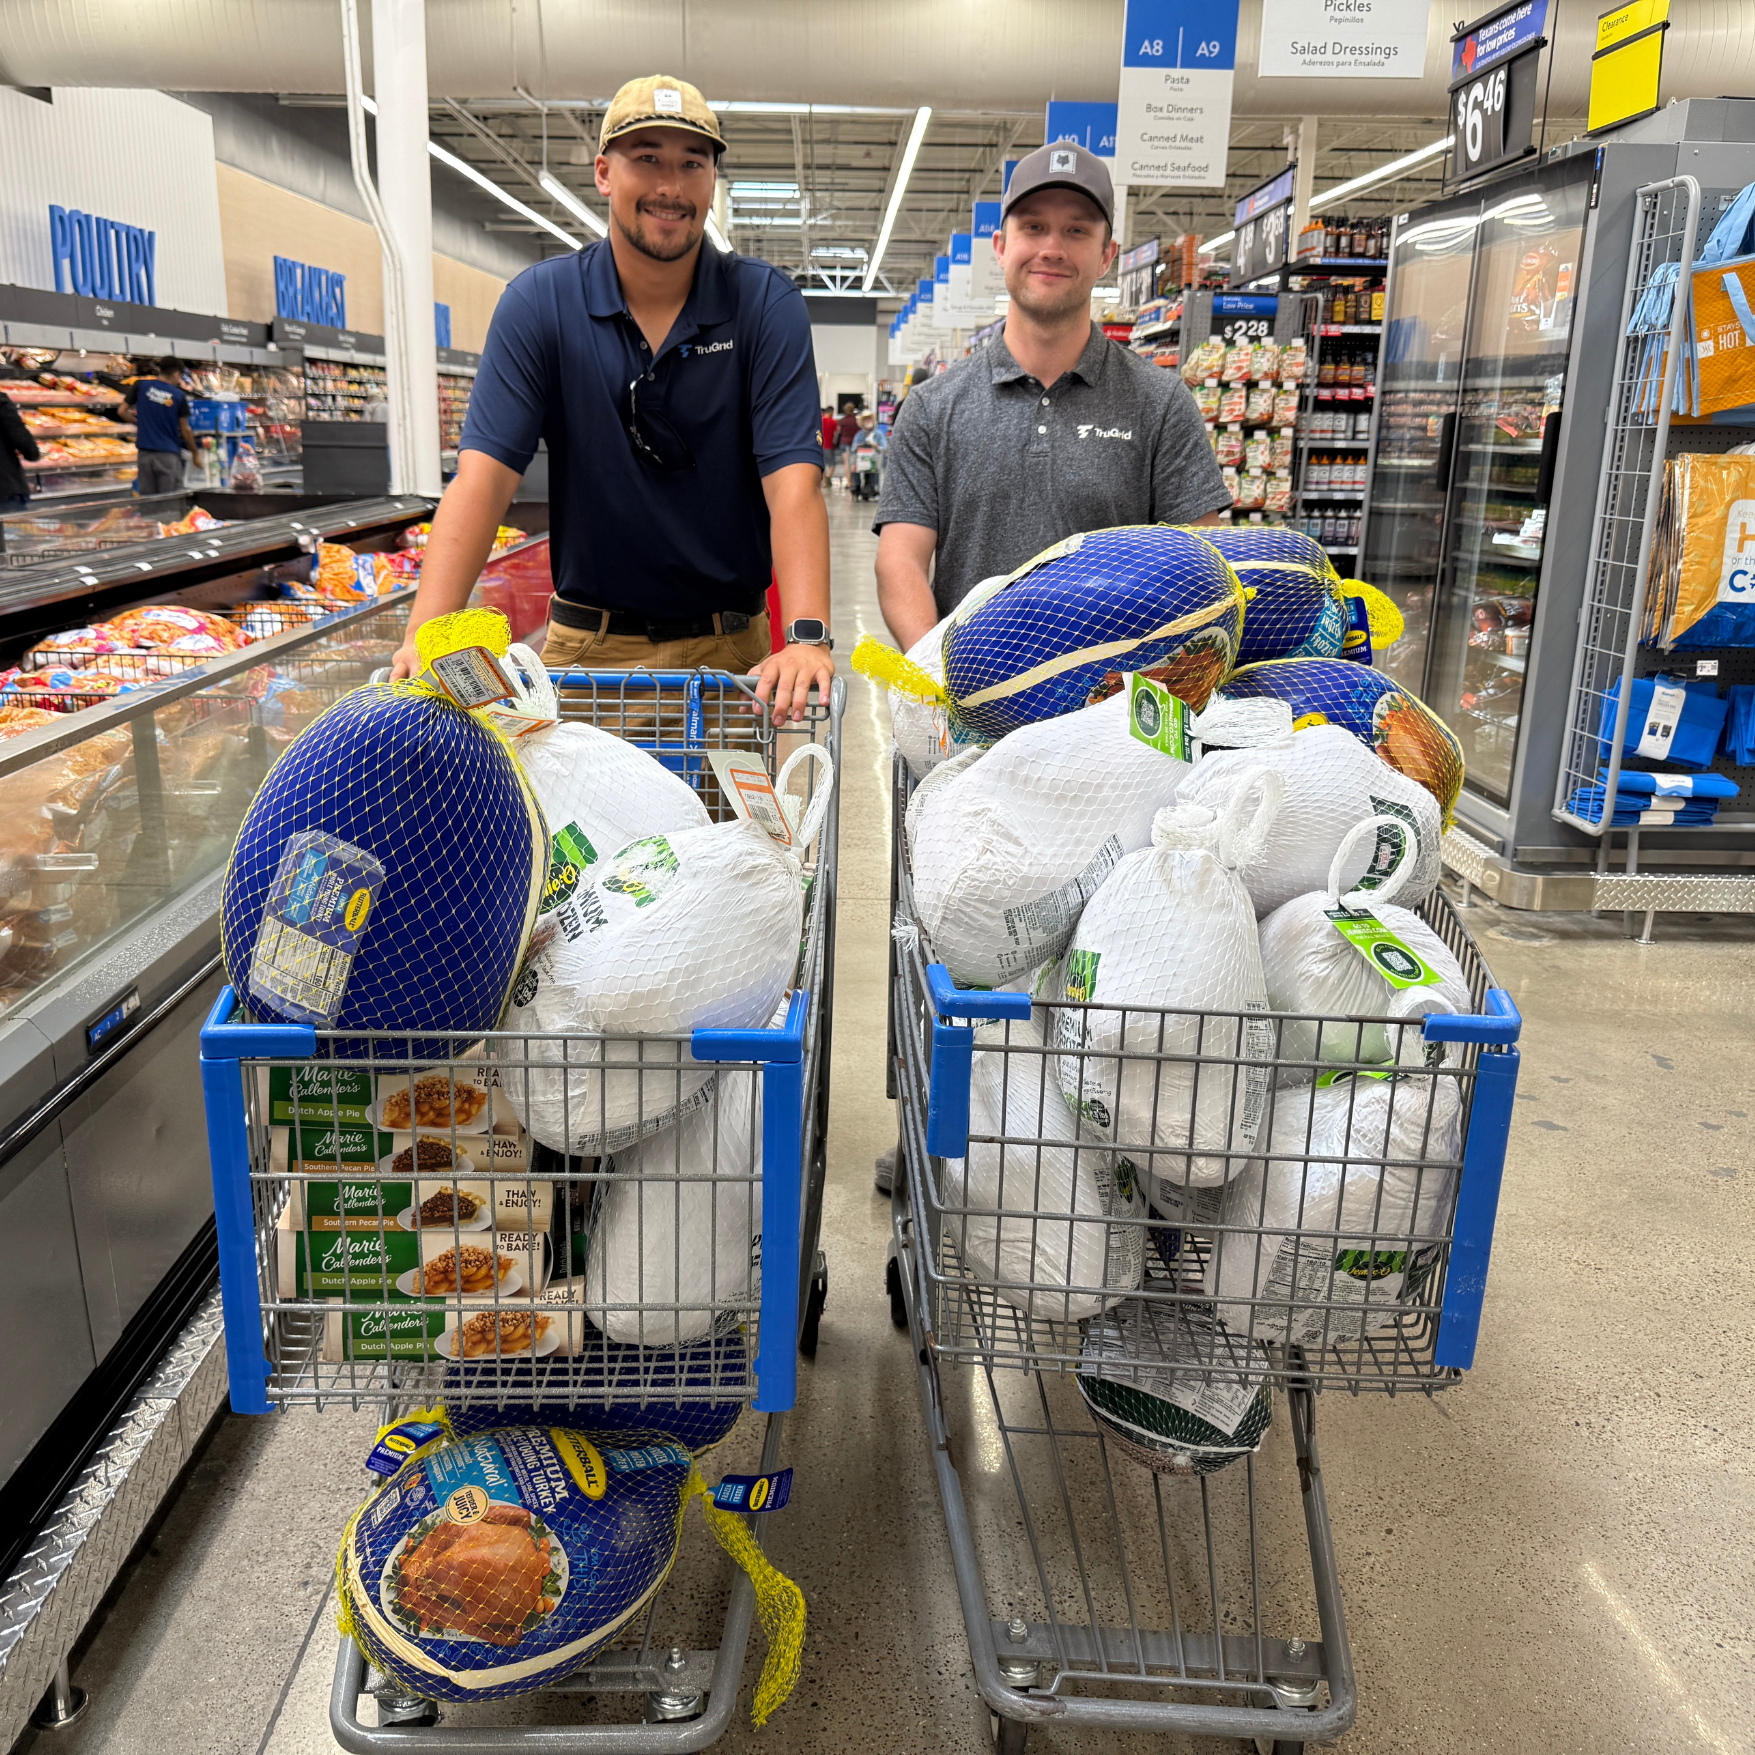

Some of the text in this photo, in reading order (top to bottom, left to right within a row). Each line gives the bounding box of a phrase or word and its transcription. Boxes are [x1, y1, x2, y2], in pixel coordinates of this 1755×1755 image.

[1324, 0, 1372, 12] Pickles
[1479, 3, 1532, 42] Texans come here
[1602, 13, 1629, 33] Clearance
[1139, 39, 1164, 56] A8
[1195, 41, 1220, 57] A9
[1477, 44, 1486, 58] for
[1496, 27, 1516, 49] prices
[1290, 41, 1398, 59] Salad Dressings
[1164, 74, 1190, 85] Pasta
[1145, 103, 1204, 115] Box Dinners
[1140, 133, 1204, 144] Canned Meat
[1131, 162, 1209, 173] Canned Seafood
[48, 204, 156, 307] POULTRY
[274, 255, 346, 330] BREAKFAST
[1237, 302, 1254, 310] Price
[1717, 322, 1741, 333] STAYS
[1719, 331, 1740, 350] HOT
[694, 340, 734, 355] TruGrid
[1094, 427, 1132, 440] TruGrid
[1731, 557, 1742, 565] or
[323, 877, 345, 923] PREMIUM
[348, 891, 367, 929] BUTTERBALL
[288, 1106, 360, 1118] Dtch Appe Pie
[486, 1150, 522, 1158] ENJOY!
[304, 1163, 338, 1171] Southern
[505, 1199, 541, 1208] ENJOY!
[500, 1233, 538, 1242] READY
[506, 1242, 540, 1251] BAKE!
[350, 1278, 375, 1286] Apple
[540, 1289, 577, 1300] READY
[390, 1342, 413, 1350] Apple
[376, 1446, 405, 1461] PREMIUM
[530, 1469, 557, 1513] TURKEY
[752, 1480, 766, 1508] BUTTERBALL
[765, 1476, 779, 1509] PREMIUM
[453, 1495, 473, 1520] JUICY
